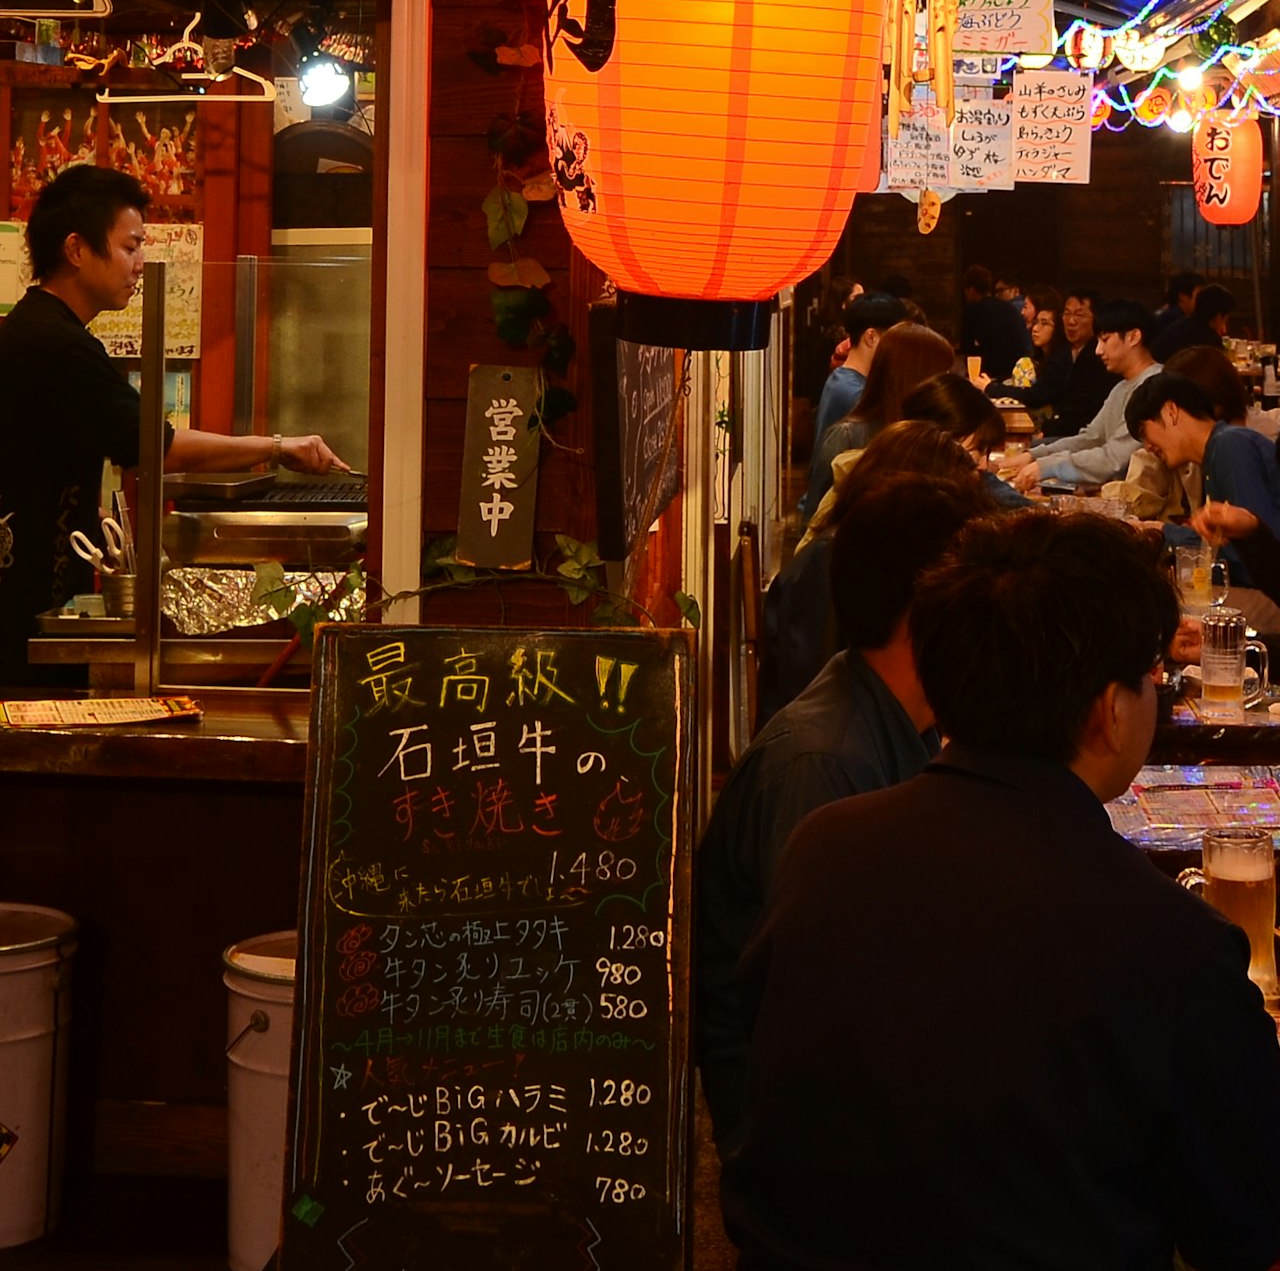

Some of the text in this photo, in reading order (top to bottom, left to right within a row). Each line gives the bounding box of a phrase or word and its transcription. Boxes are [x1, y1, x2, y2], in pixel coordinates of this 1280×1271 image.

[962, 31, 1028, 49] ミミガー
[1019, 82, 1087, 102] 山羊のさしみ
[1204, 126, 1231, 205] おでん
[478, 398, 524, 538] 営業中
[377, 720, 607, 785] 石垣牛の
[393, 778, 562, 842] すき焼き
[379, 915, 569, 954] タン芯の極上タタキ
[384, 953, 642, 993] 牛タン炙りユッケ 980
[599, 992, 648, 1020] 580
[595, 1175, 647, 1204] 780
